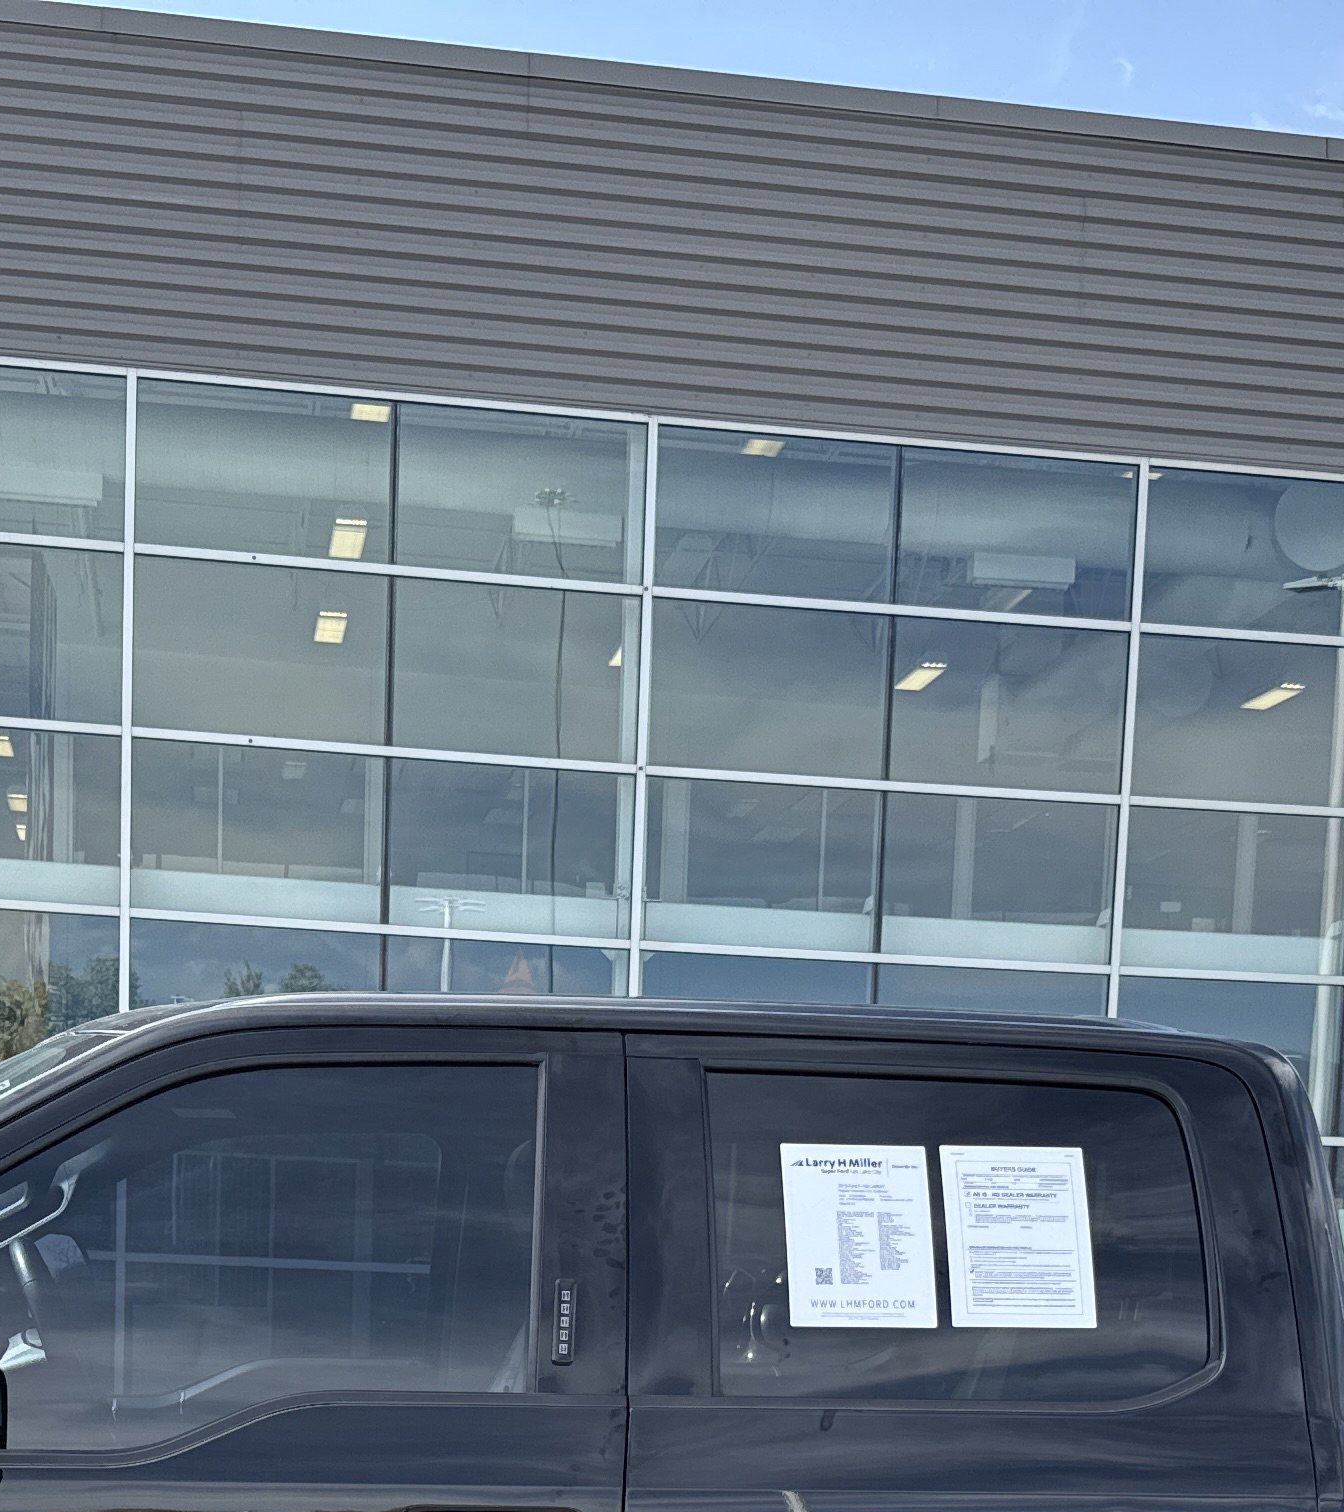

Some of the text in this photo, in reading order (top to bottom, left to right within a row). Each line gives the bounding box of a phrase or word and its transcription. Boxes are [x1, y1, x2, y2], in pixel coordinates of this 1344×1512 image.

[805, 1158, 835, 1169] Larry
[838, 1159, 847, 1167] H
[849, 1158, 883, 1168] Miller
